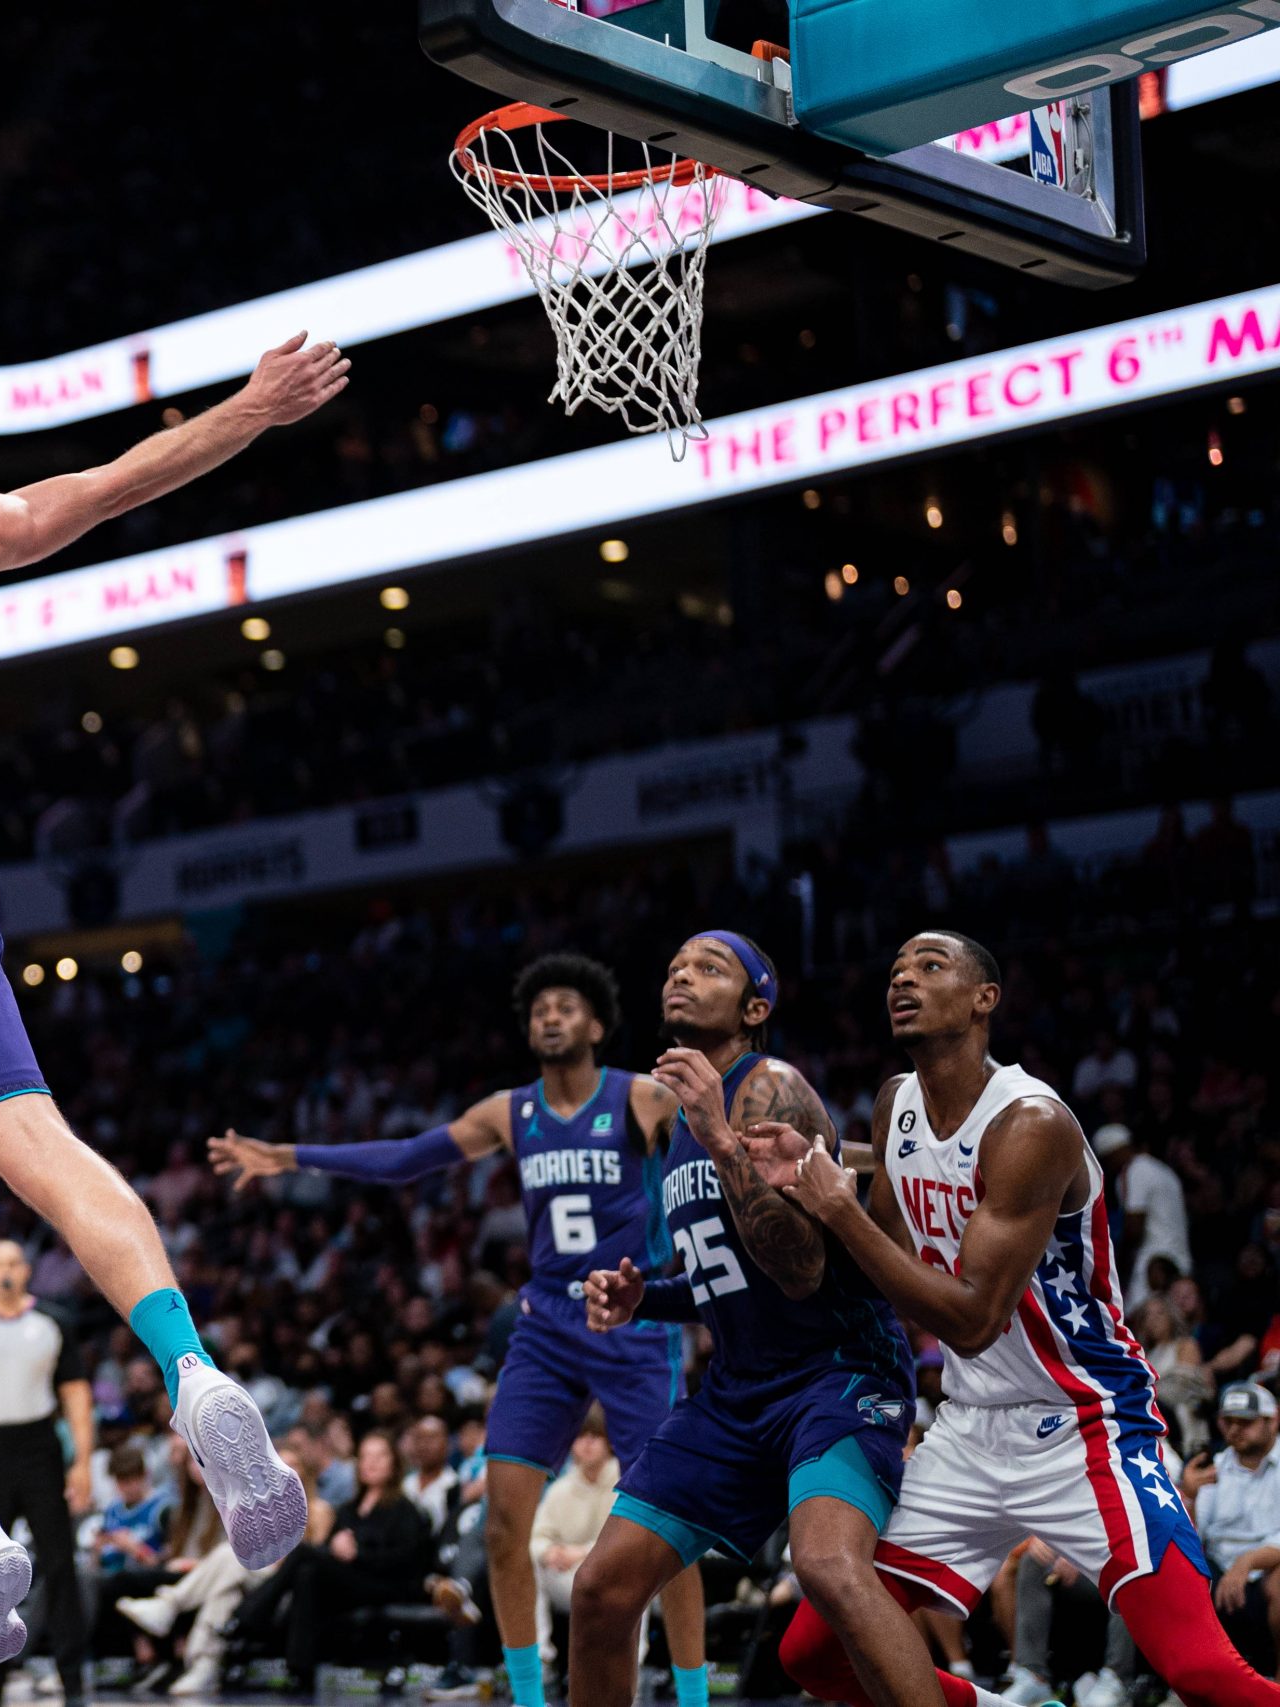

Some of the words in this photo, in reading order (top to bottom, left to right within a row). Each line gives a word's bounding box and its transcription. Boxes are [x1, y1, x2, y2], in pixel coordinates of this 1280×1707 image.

[1035, 151, 1053, 177] NBA
[694, 418, 796, 478] THE
[819, 351, 1082, 451] PERFECT
[901, 1112, 914, 1132] 6
[520, 1149, 622, 1192] HORNETS
[662, 1160, 721, 1218] ORNETS
[550, 1194, 598, 1255] 6
[673, 1216, 749, 1306] 25
[1040, 1414, 1063, 1430] NIKE
